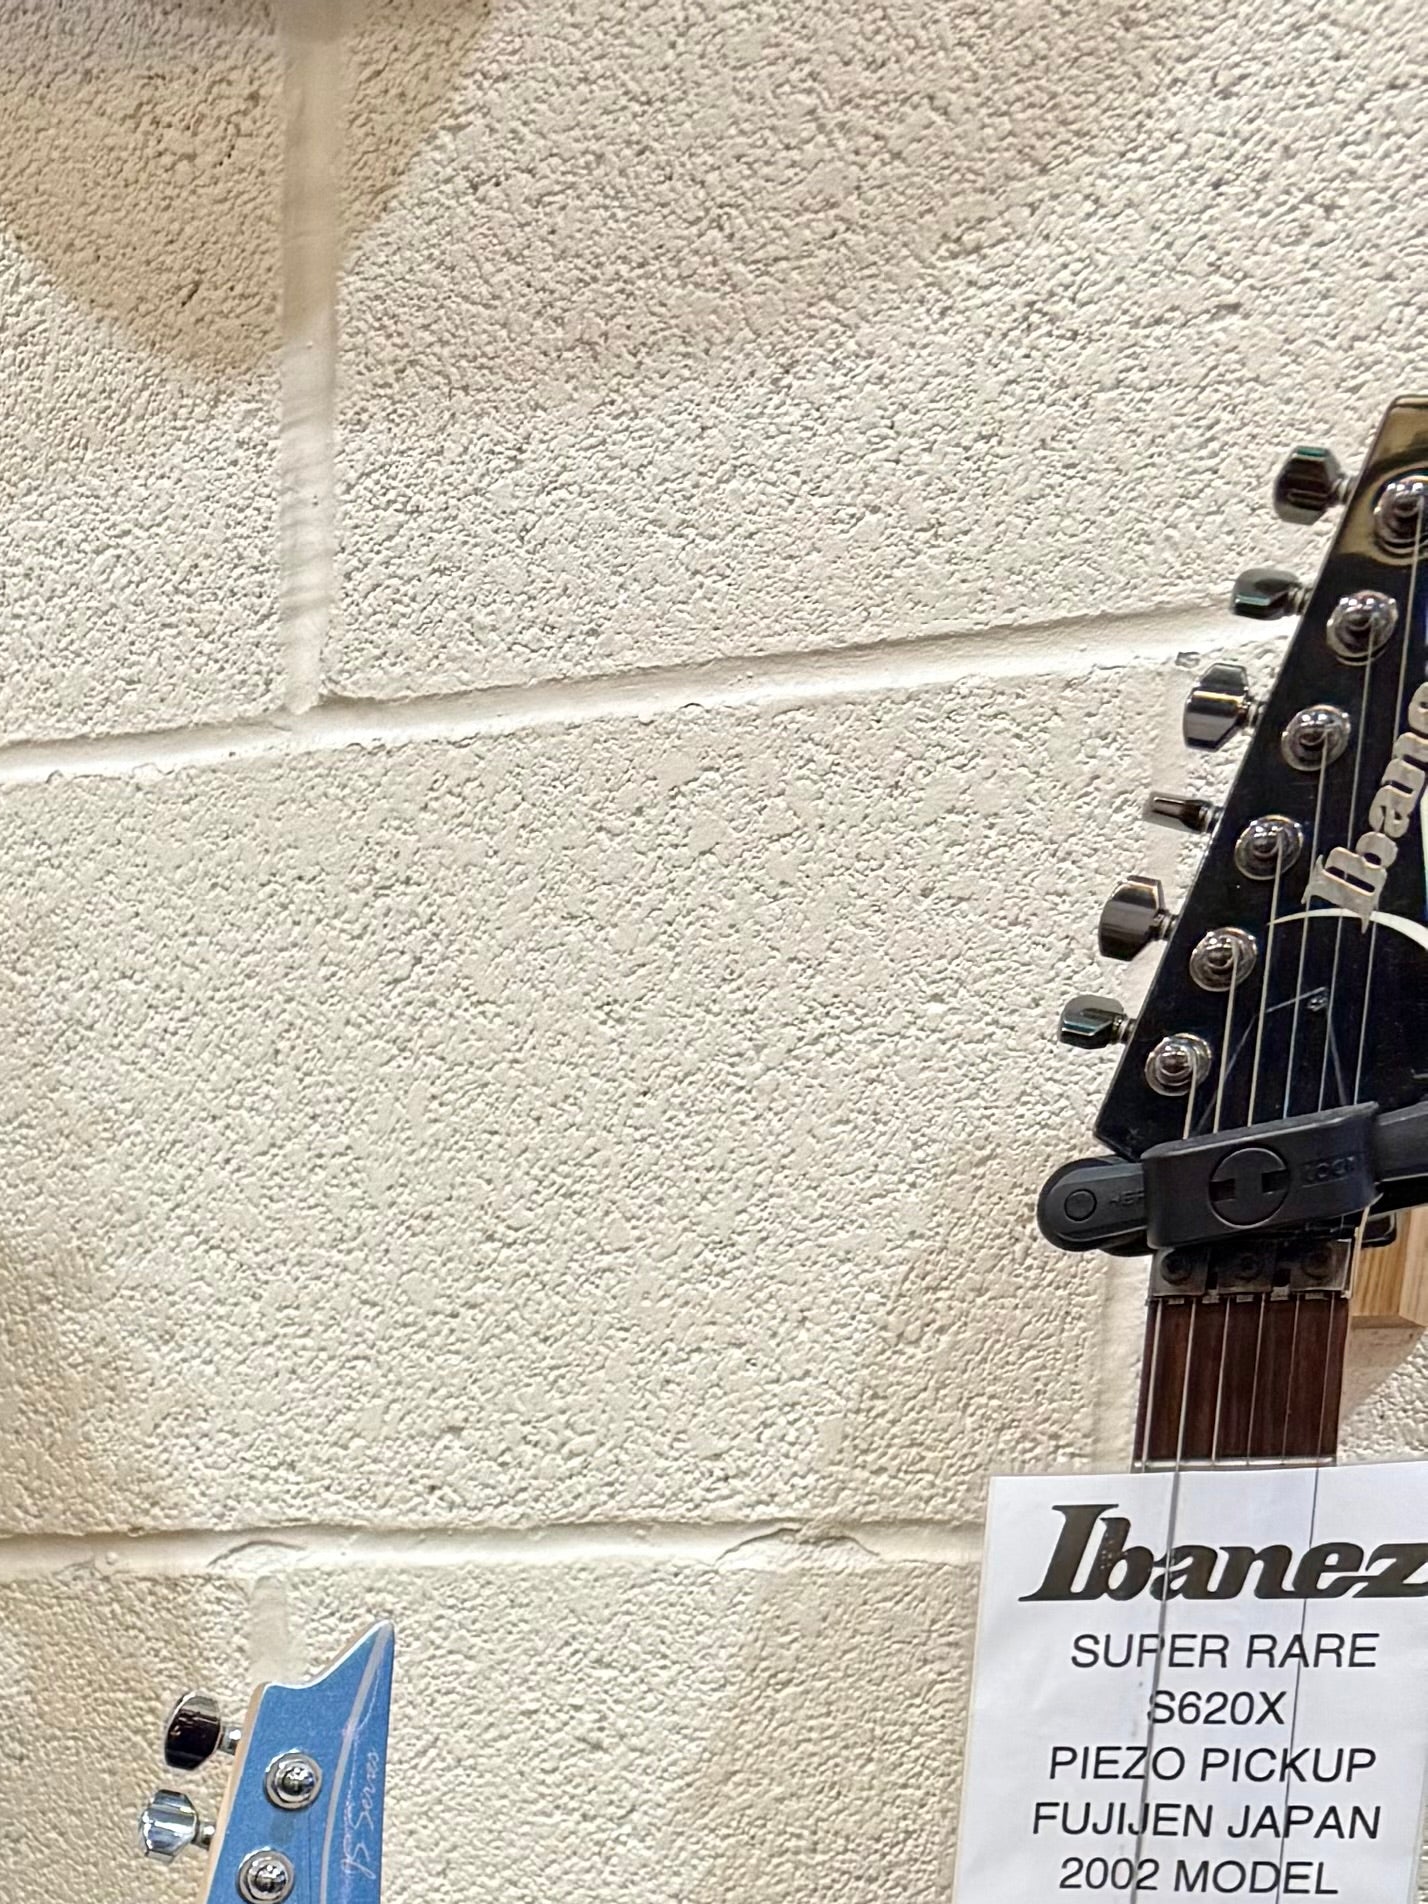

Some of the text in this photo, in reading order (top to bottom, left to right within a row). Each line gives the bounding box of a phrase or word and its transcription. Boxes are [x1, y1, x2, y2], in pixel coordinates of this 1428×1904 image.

[1301, 682, 1428, 933] Iban
[1018, 1504, 1428, 1602] Ibanez
[1071, 1633, 1379, 1669] SUPER RARE
[1150, 1690, 1287, 1725] S620X
[1049, 1747, 1377, 1783] PIEZO PICKUP
[1033, 1802, 1381, 1840] FUJIJEN JAPAN
[1059, 1857, 1338, 1895] 2002 MODEL
